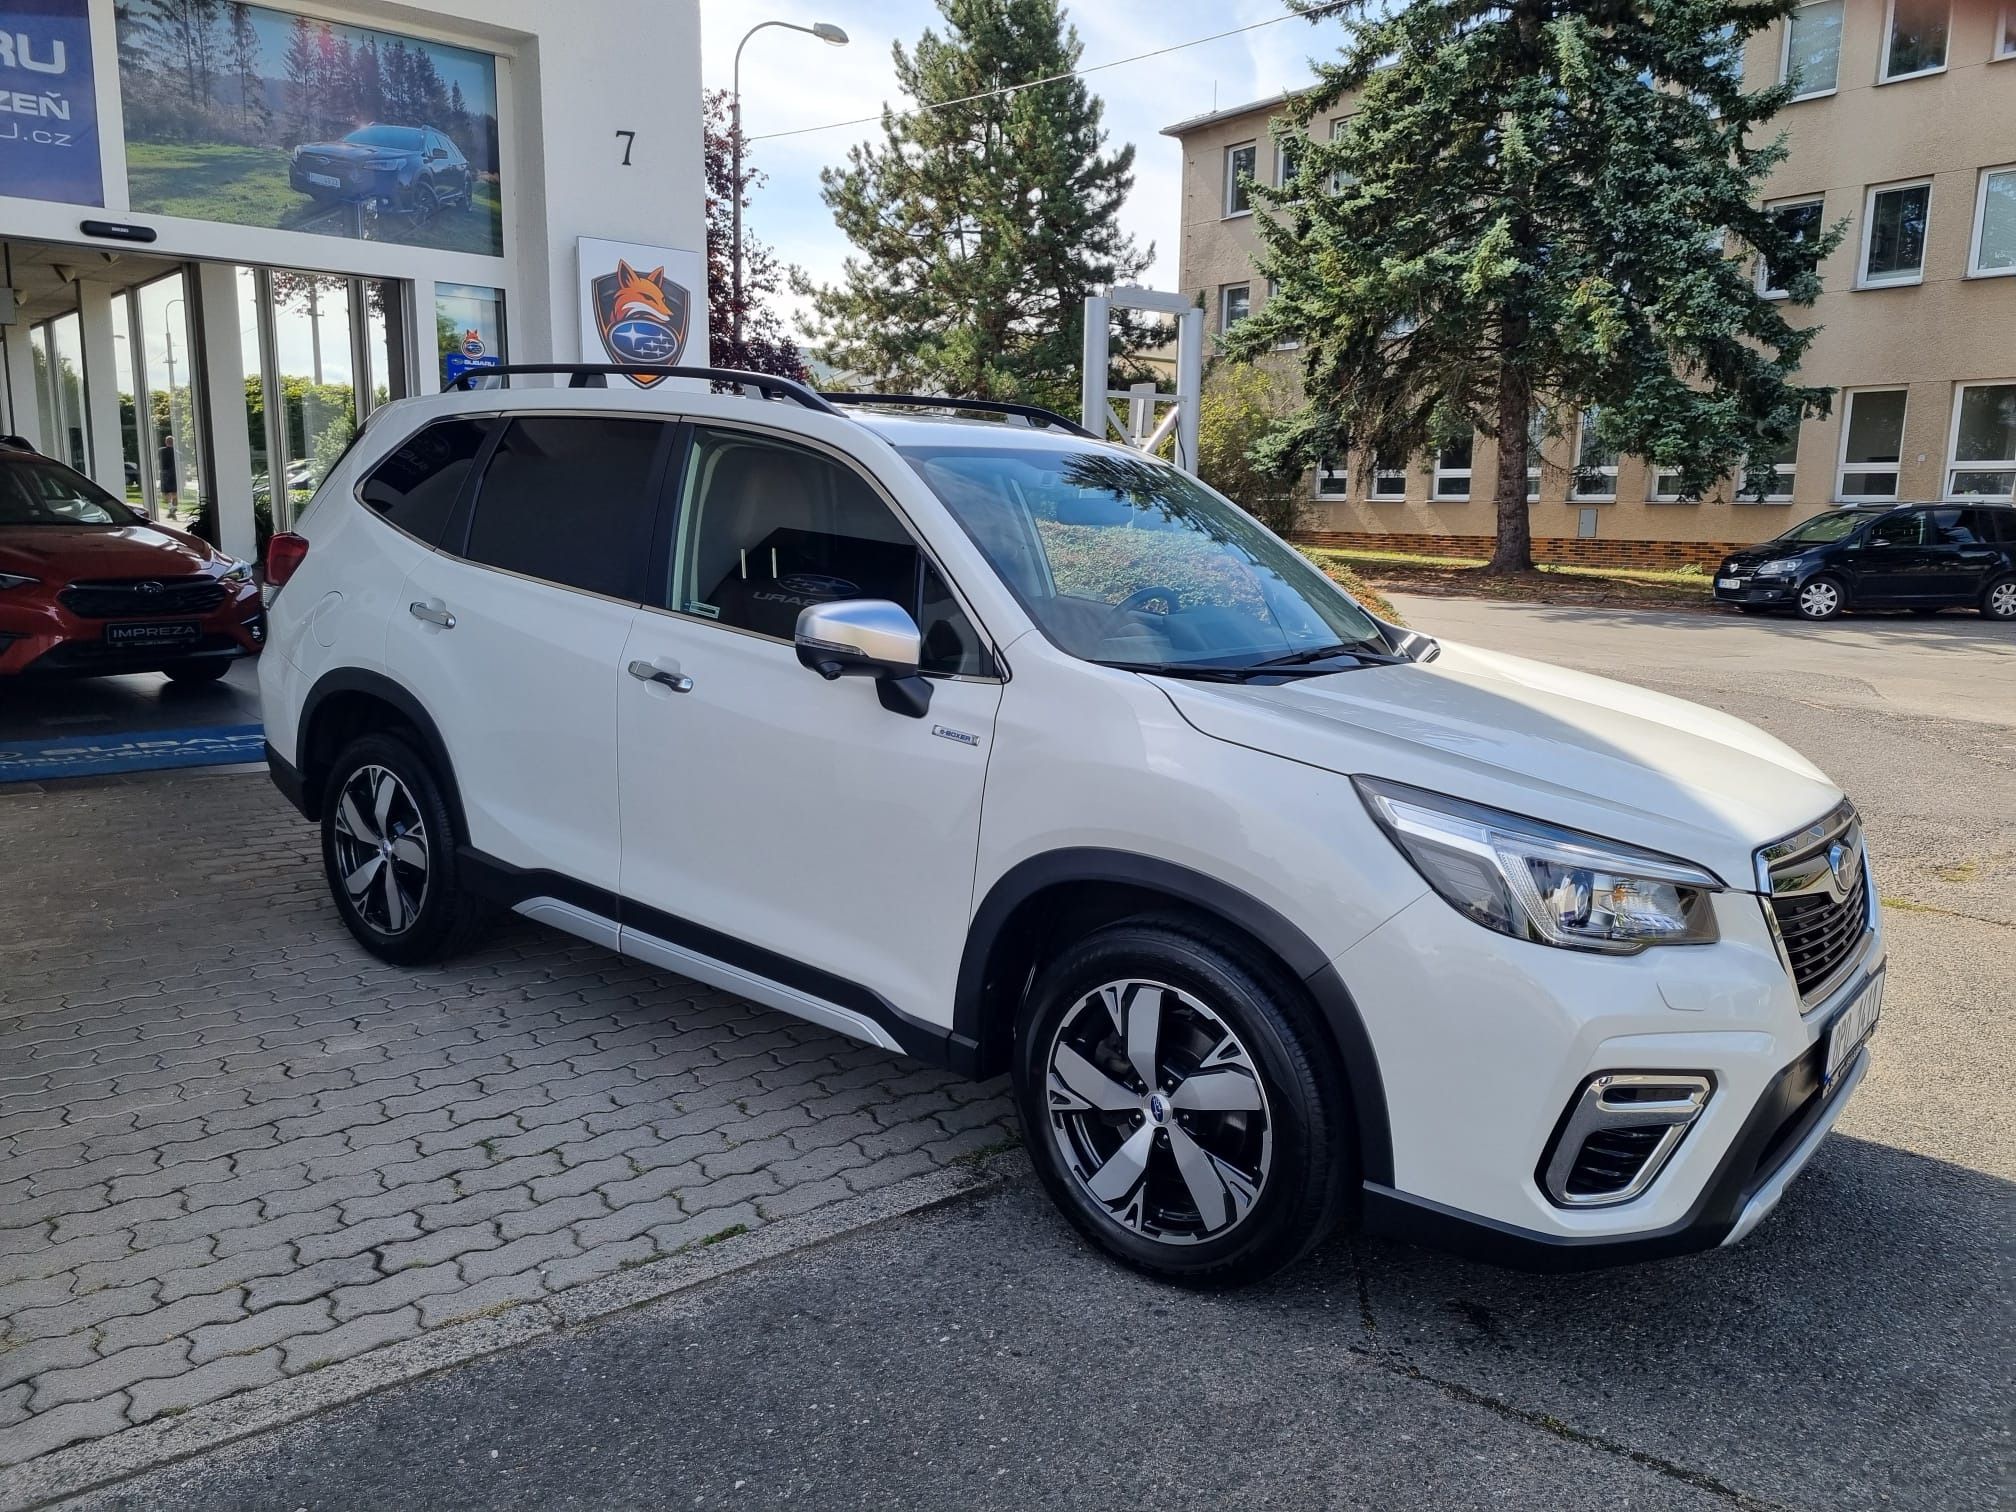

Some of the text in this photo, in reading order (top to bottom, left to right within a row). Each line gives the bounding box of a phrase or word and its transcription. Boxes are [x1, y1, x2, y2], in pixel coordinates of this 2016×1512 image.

[616, 130, 635, 166] 7
[464, 359, 495, 367] SUBARU
[113, 626, 195, 638] IMPREZA
